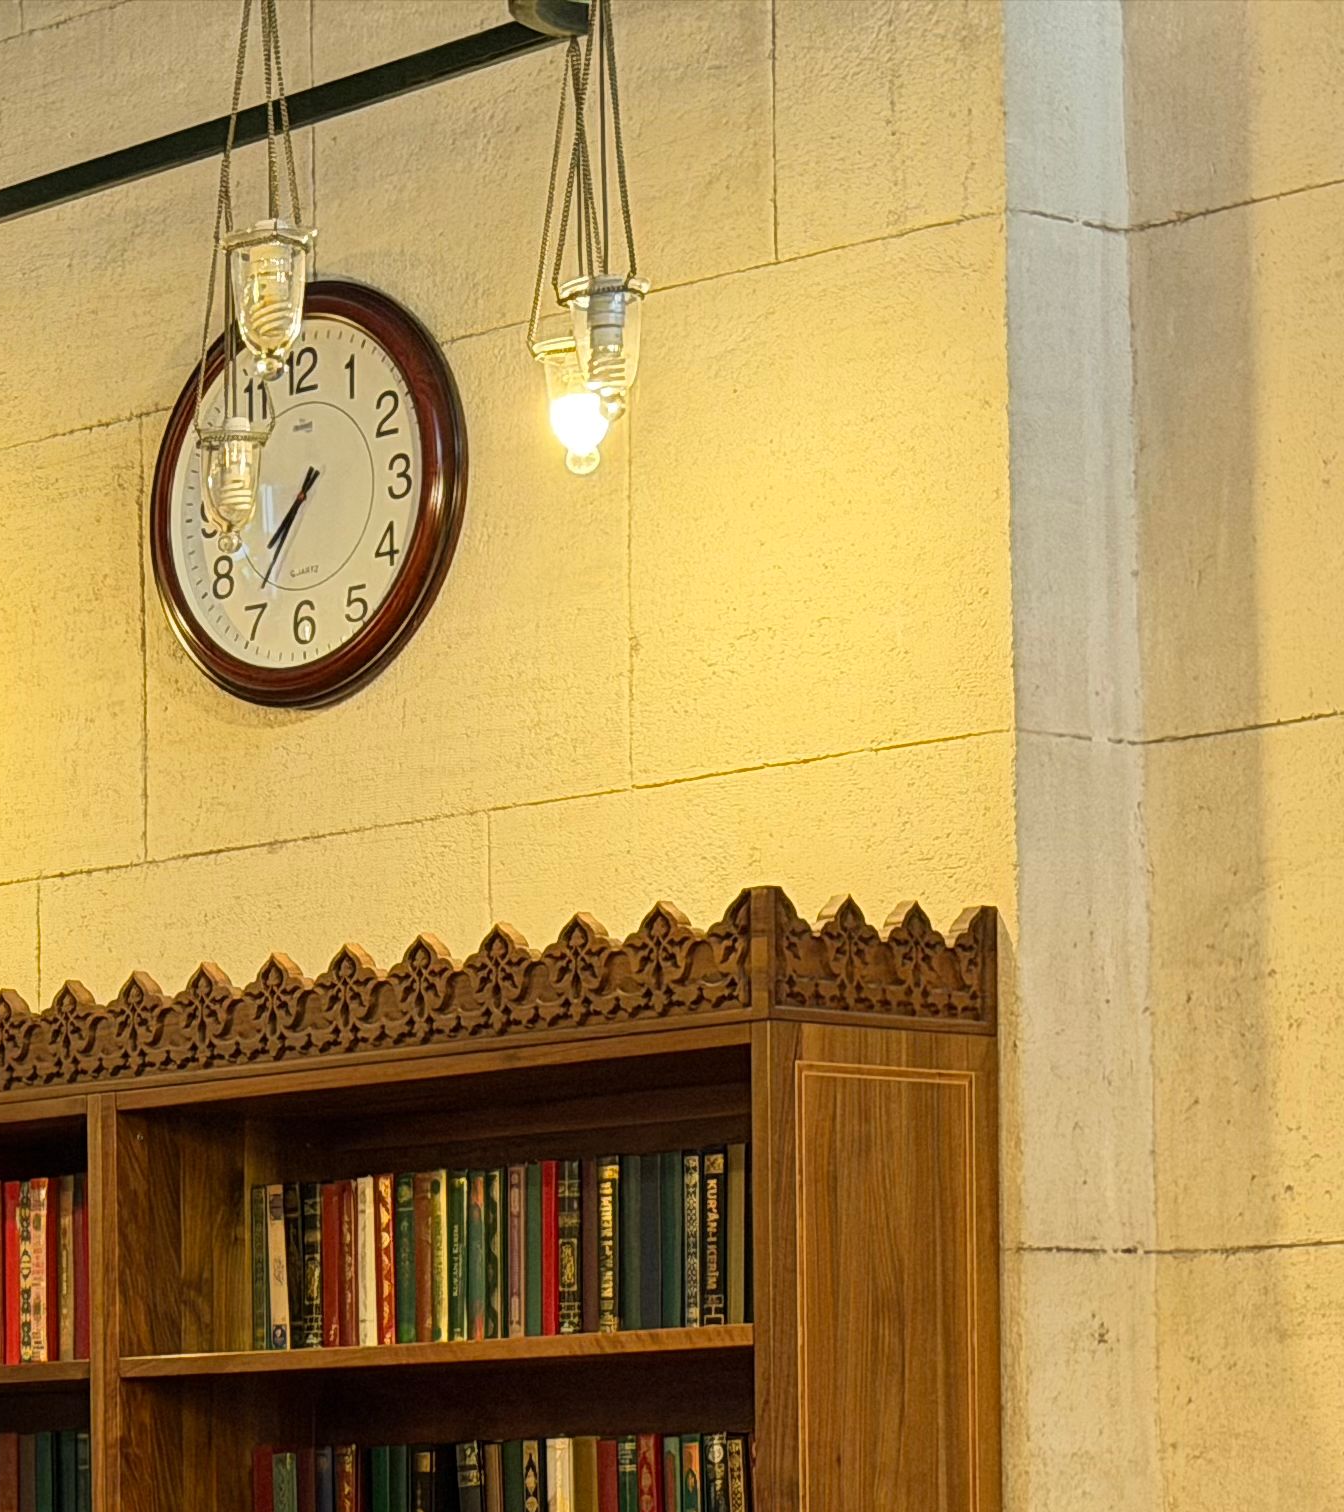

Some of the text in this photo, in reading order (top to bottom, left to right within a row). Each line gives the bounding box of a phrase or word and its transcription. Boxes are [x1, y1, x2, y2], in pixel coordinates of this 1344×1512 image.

[286, 346, 318, 397] 12
[344, 353, 356, 400] 1
[243, 377, 269, 423] 11
[375, 390, 400, 439] 2
[387, 453, 413, 500] 3
[374, 520, 400, 567] 4
[212, 554, 234, 600] 8
[244, 602, 268, 642] 7
[292, 599, 316, 645] 6
[344, 583, 369, 624] 5
